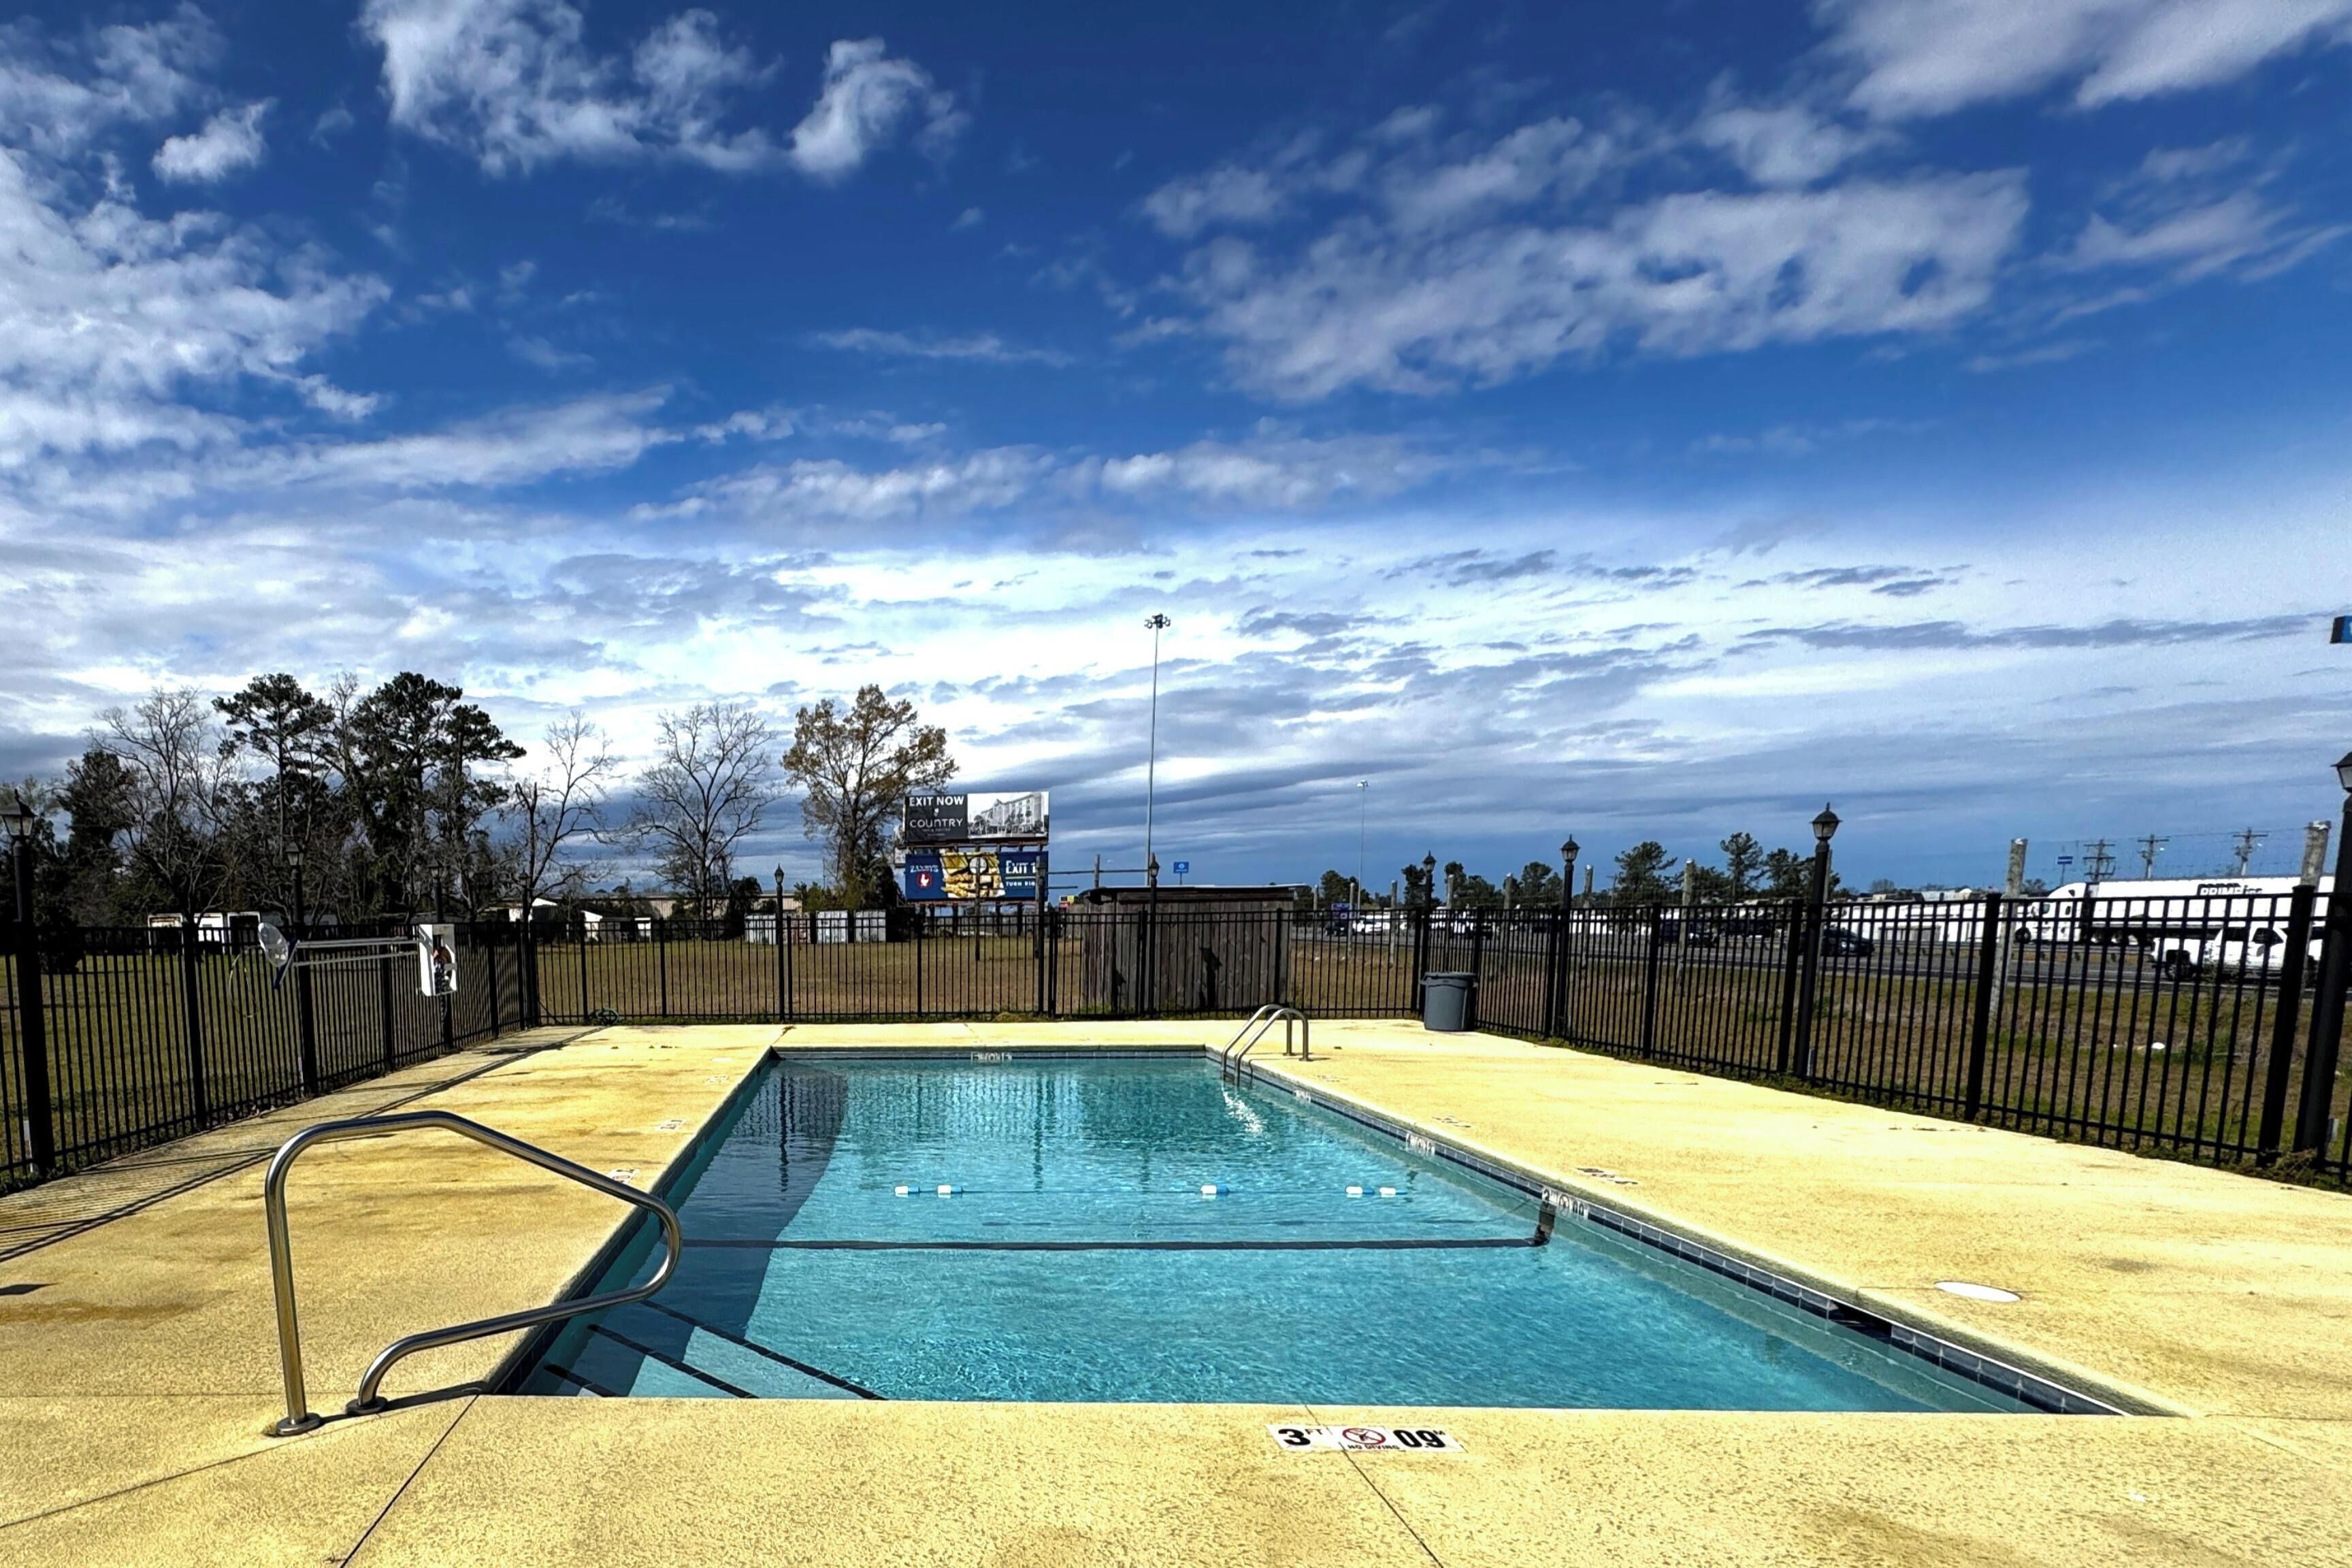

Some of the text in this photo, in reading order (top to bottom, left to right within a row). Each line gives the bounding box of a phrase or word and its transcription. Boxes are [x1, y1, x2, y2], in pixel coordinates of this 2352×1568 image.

[909, 796, 964, 806] EXIT NOW
[909, 818, 963, 828] COUNTRY
[1006, 860, 1028, 874] EXIT
[1278, 1428, 1311, 1446] 3
